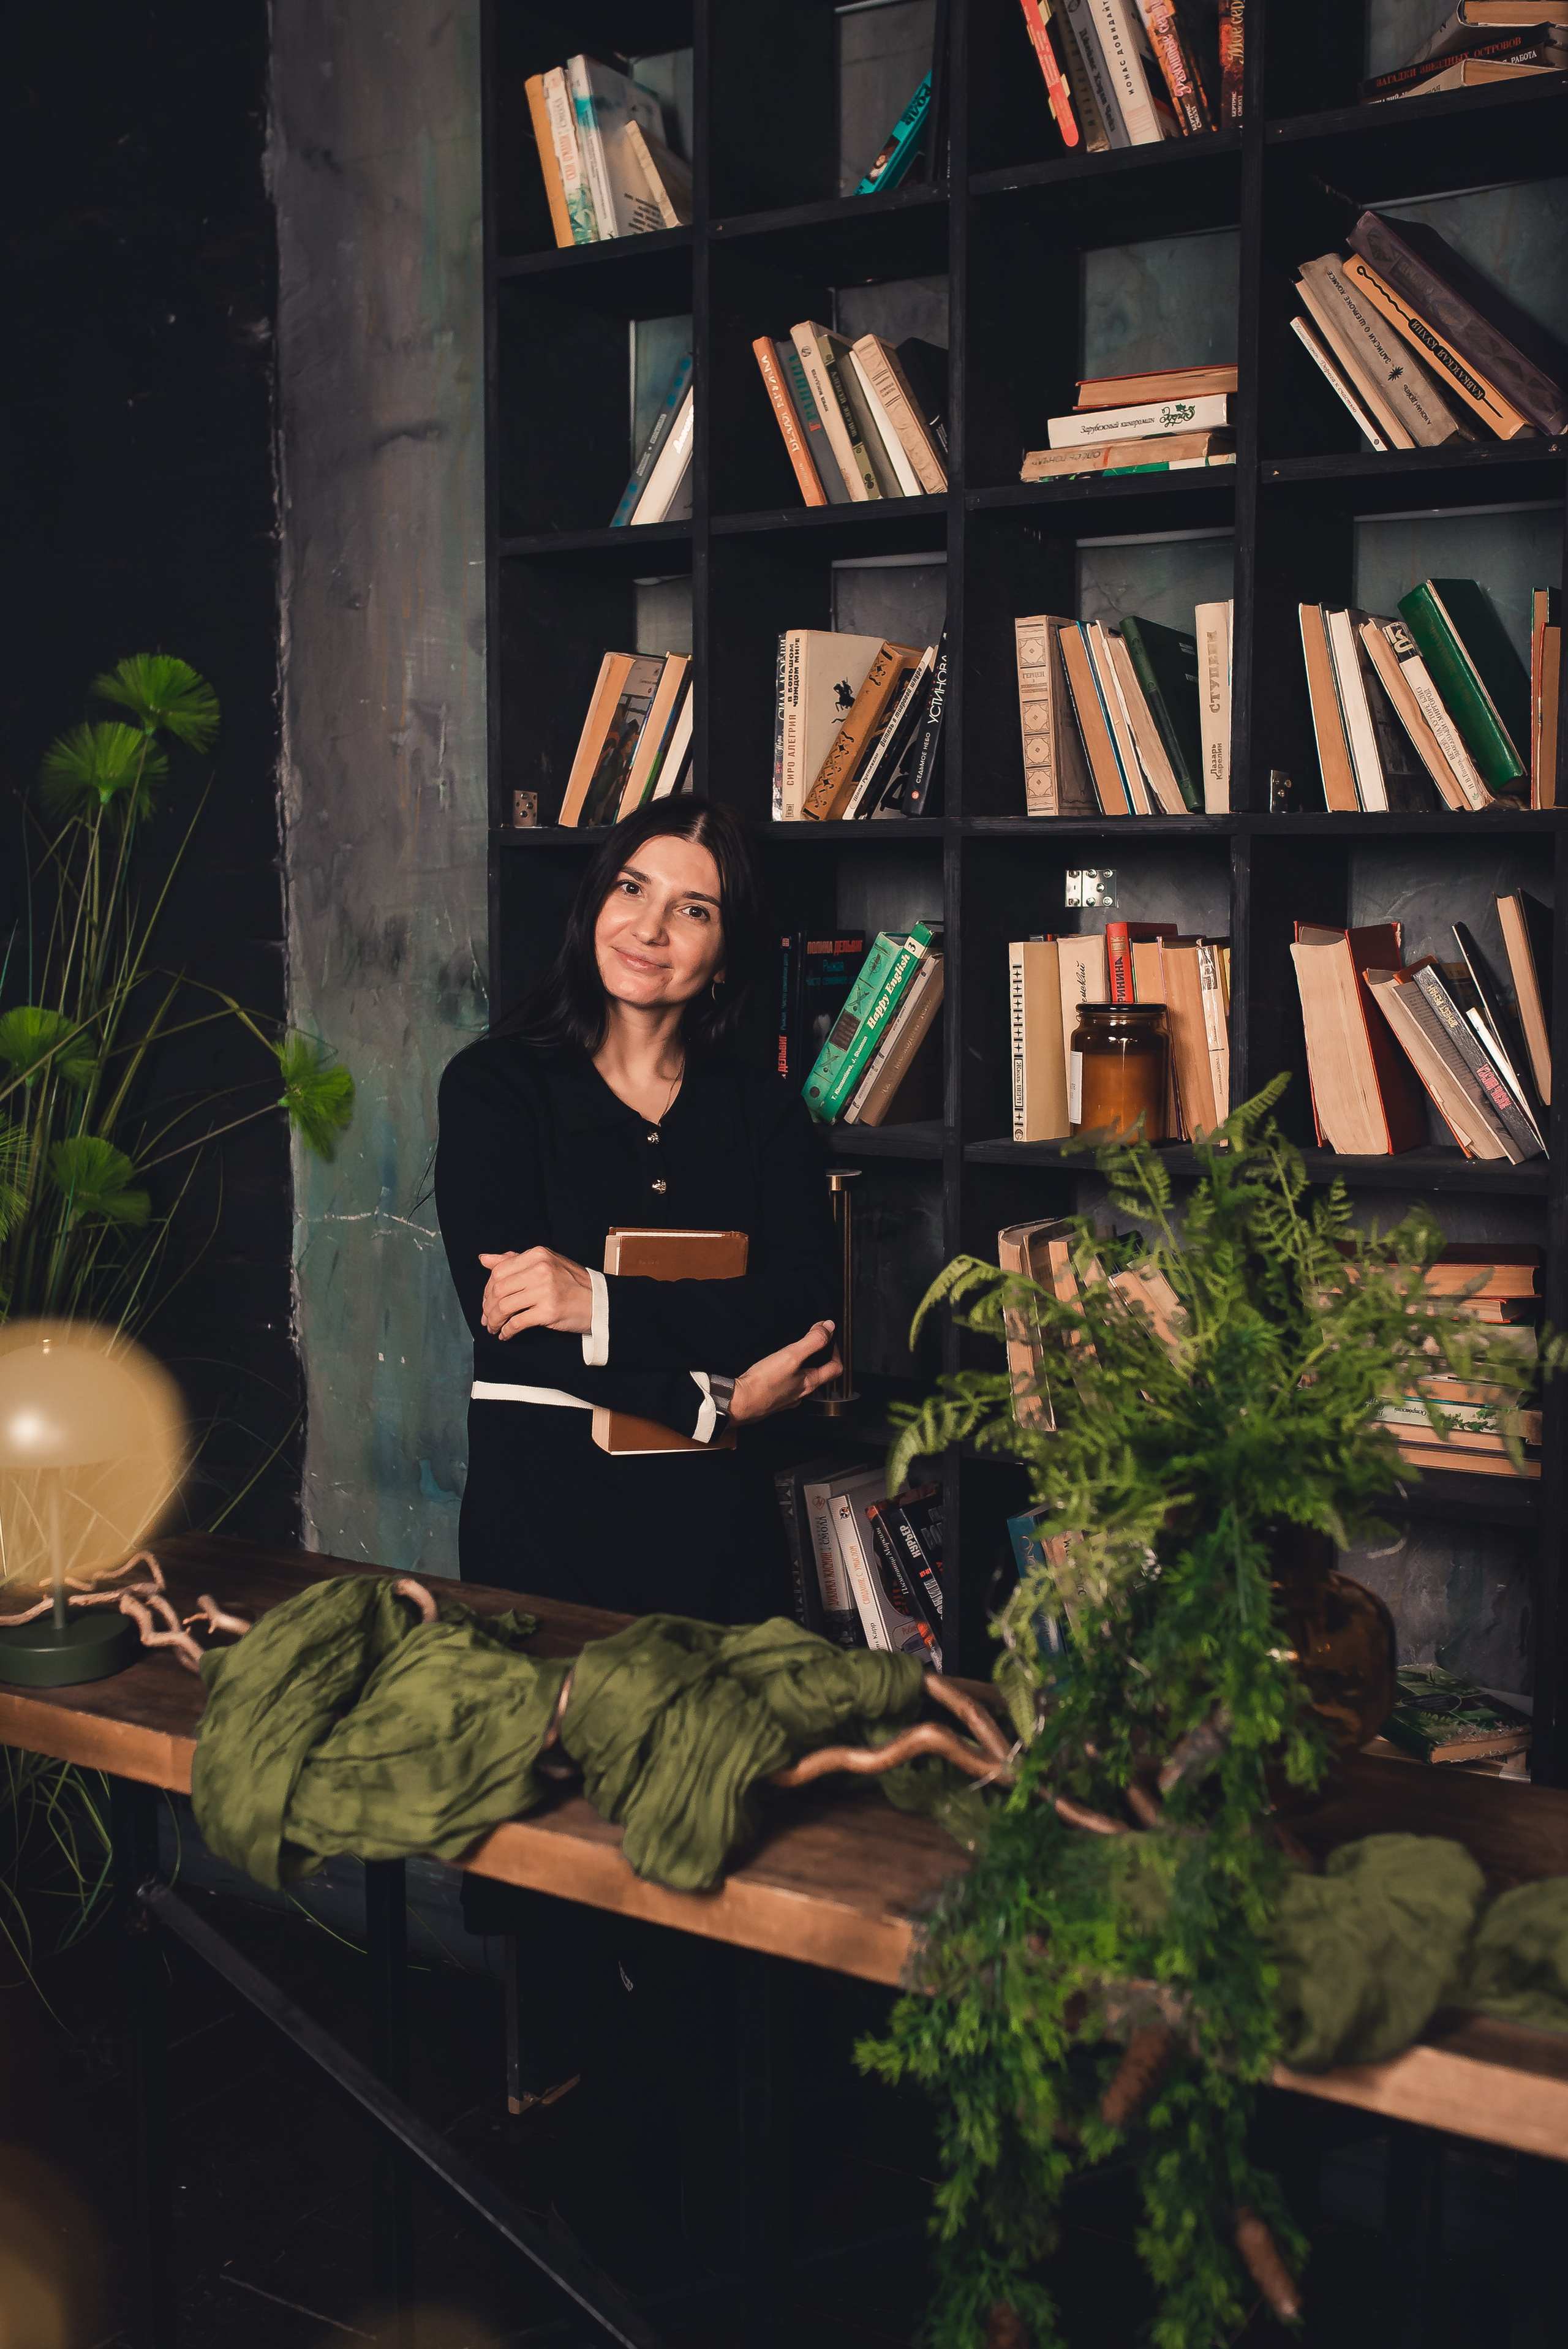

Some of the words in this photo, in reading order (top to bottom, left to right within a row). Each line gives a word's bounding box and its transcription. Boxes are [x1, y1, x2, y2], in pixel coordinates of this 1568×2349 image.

[1230, 0, 1245, 24] сер
[1227, 26, 1244, 64] Мое
[1510, 49, 1537, 65] РАБОТА
[1374, 68, 1417, 88] ЗАГАДКИ
[1472, 36, 1523, 58] ОСТРОВОВ
[1118, 59, 1135, 95] ИОНАС
[1325, 270, 1347, 296] ХОЛМСЕ
[1342, 295, 1368, 326] ШЕРЛОКЕ
[1366, 333, 1392, 364] ЗАПИСКИ
[1409, 320, 1438, 349] КУХНЯ
[1317, 358, 1338, 383] Дорога
[1336, 386, 1359, 413] счастью
[1434, 349, 1485, 399] КАВКАЗСКАЯ
[1400, 383, 1417, 404] ДОЙЛЬ
[1414, 402, 1429, 421] КОНАН
[926, 654, 949, 725] УСТИНОВА
[1414, 686, 1428, 703] БЛИЗ
[1422, 687, 1445, 721] МИРГОРОД
[1423, 704, 1440, 728] ХУТОРЕ
[787, 714, 796, 756] АЛЕГРИЯ
[852, 783, 864, 802] Шота
[861, 751, 879, 784] Руставели
[879, 722, 894, 747] Витязь
[894, 688, 913, 718] тигровой
[908, 666, 923, 688] шкуре
[1435, 727, 1444, 737] НА
[1215, 743, 1224, 780] Карелин
[1439, 737, 1456, 760] ВЕЧЕРА
[786, 761, 795, 785] СИРО
[915, 751, 927, 784] СЕДЬМОЕ
[907, 941, 916, 953] 3
[853, 1035, 869, 1058] Shannon
[865, 992, 892, 1031] Happy
[883, 951, 913, 996] English
[1427, 983, 1444, 1006] РЕНАН
[1439, 1003, 1458, 1028] ЭРНЕСТ
[778, 1035, 788, 1073] ДЕЛЬВИГ
[819, 1515, 830, 1545] СМОЛЛ
[899, 1523, 922, 1558] КУРЬЕР
[821, 1552, 834, 1578] ЖАСМИН
[849, 1545, 861, 1570] УМЫСЛОМ
[824, 1580, 839, 1607] ДИКАРКА
[858, 1577, 870, 1605] СВИДАНИЕ
[869, 1623, 878, 1639] Карр
